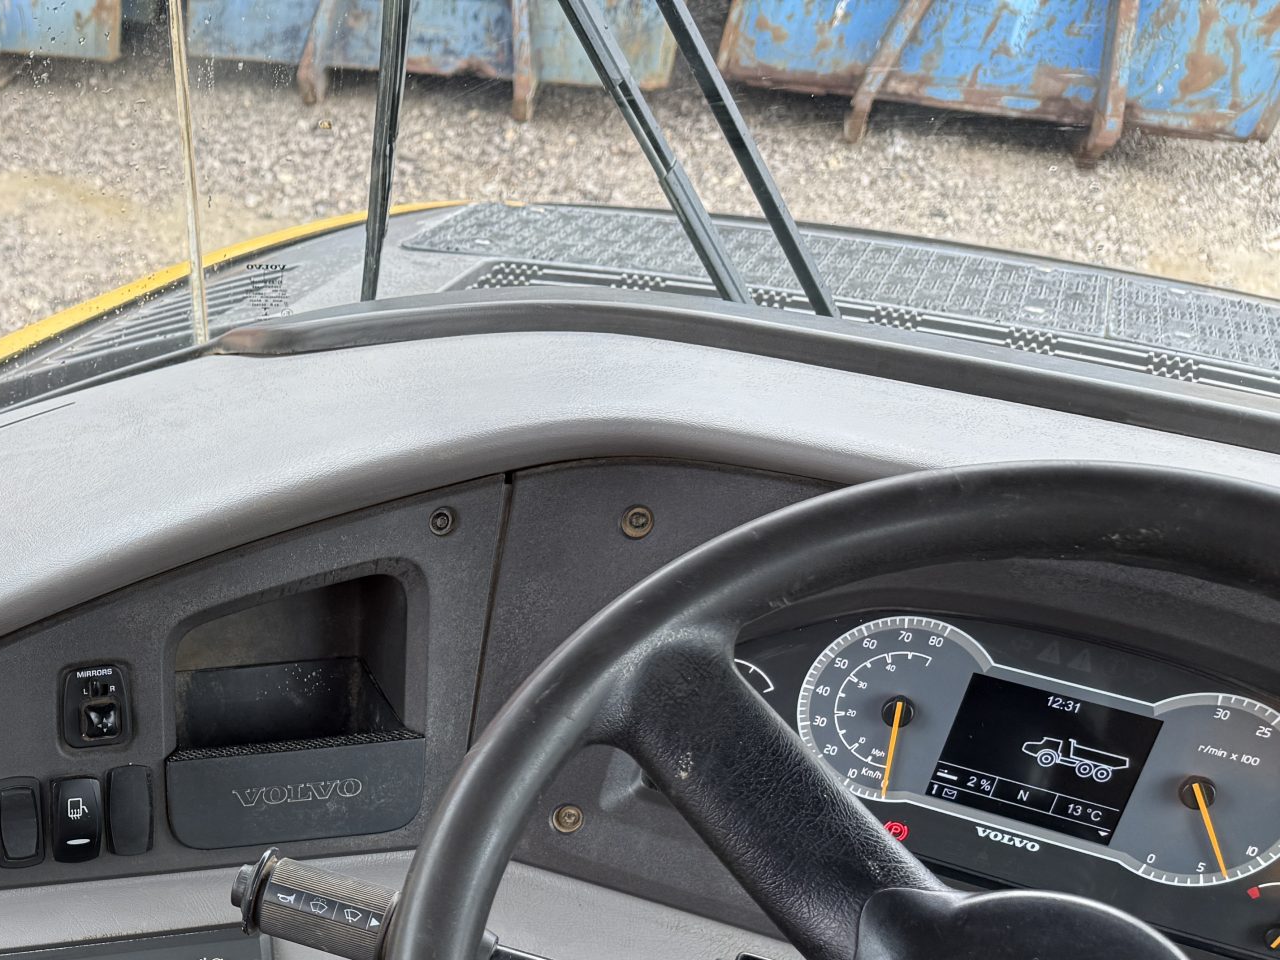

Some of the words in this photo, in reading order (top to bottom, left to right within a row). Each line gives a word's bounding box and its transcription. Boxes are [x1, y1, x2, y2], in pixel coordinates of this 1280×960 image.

[898, 631, 912, 642] 70
[928, 636, 944, 647] 80
[862, 638, 877, 649] 60
[834, 658, 848, 669] 50
[885, 663, 896, 672] 40
[77, 668, 113, 678] MIRRORS
[816, 685, 831, 696] 40
[857, 681, 867, 689] 30
[1047, 696, 1081, 714] 12:31
[846, 709, 856, 717] 20
[1213, 708, 1230, 721] 30
[813, 716, 827, 727] 30
[1256, 725, 1272, 738] 25
[858, 736, 866, 744] 10
[823, 744, 837, 756] 20
[871, 748, 885, 758] Mph
[1198, 744, 1227, 758] r/min
[1230, 753, 1238, 761] x
[1240, 754, 1260, 766] 100
[848, 768, 858, 778] 10
[861, 767, 882, 780] Km/h
[232, 778, 362, 807] VOLVO
[1017, 790, 1030, 801] N
[1067, 803, 1082, 816] 13
[976, 827, 1040, 852] VOLVO
[1246, 846, 1258, 857] 10
[1147, 854, 1156, 863] 0
[1196, 863, 1206, 873] 5
